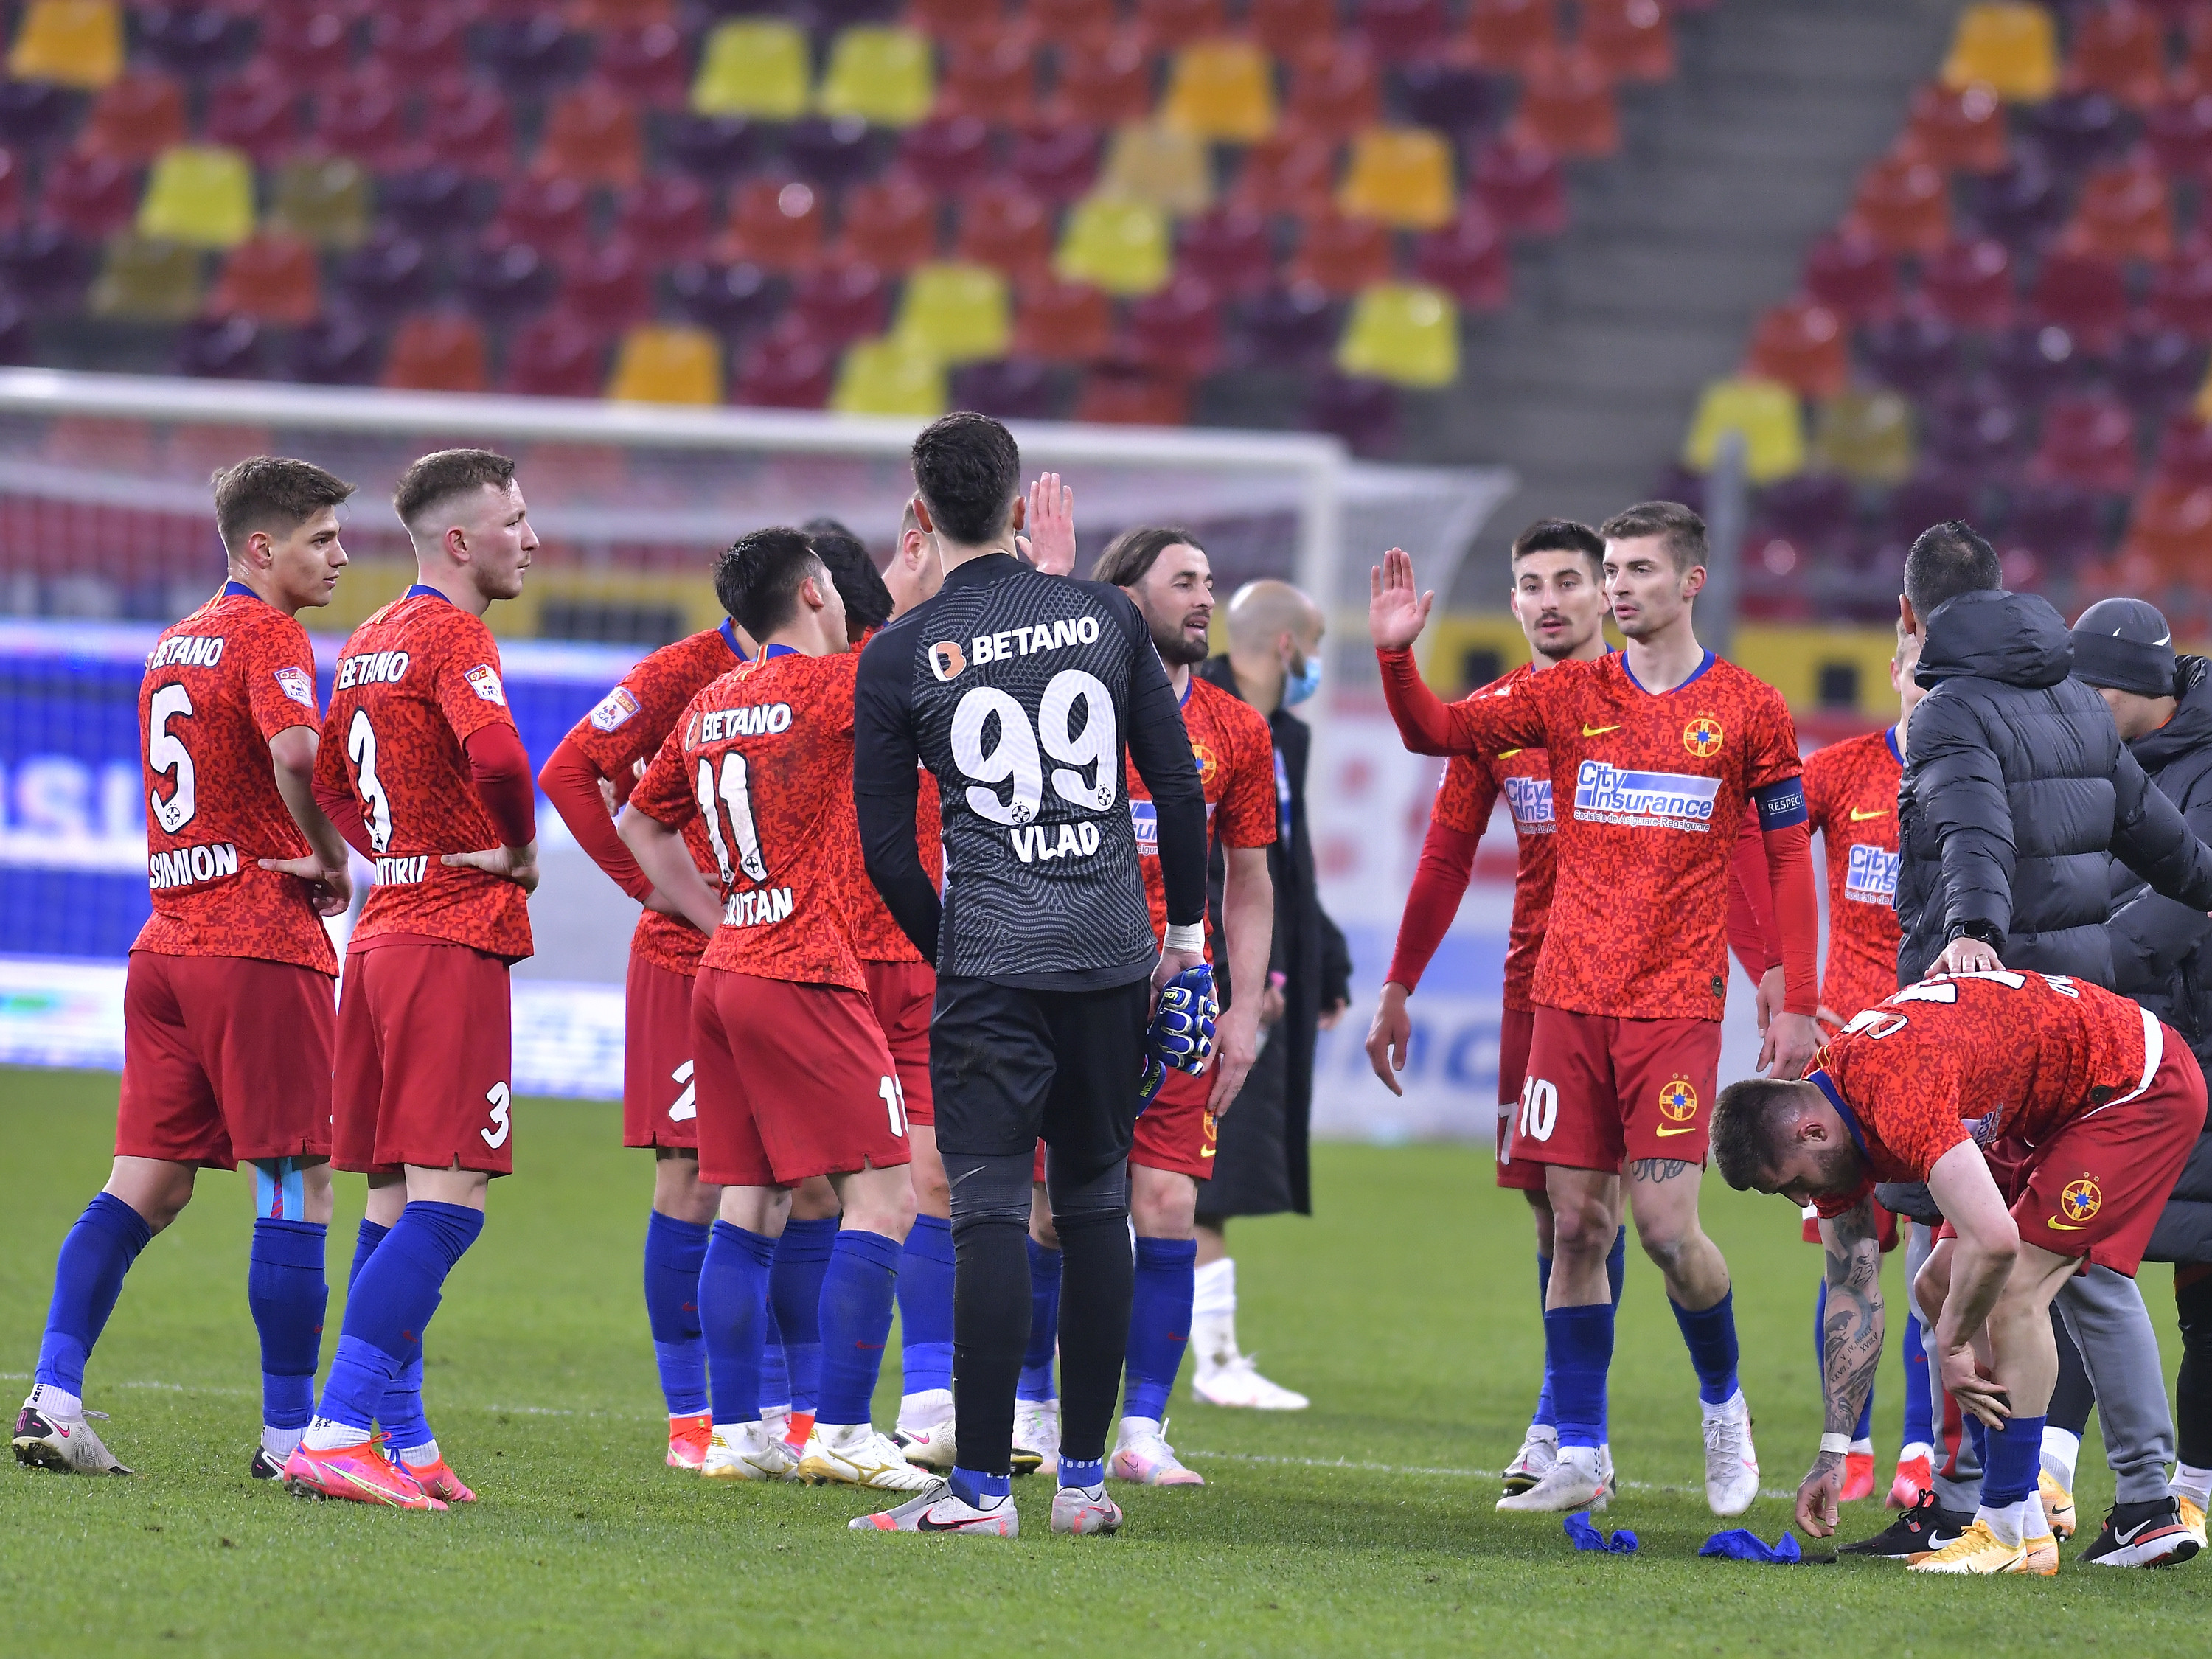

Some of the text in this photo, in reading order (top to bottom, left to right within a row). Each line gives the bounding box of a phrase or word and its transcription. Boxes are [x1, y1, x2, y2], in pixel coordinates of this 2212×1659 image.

[151, 635, 225, 670] BETANO
[972, 616, 1100, 667] BETANO
[338, 650, 411, 690] BETANO
[700, 702, 793, 744] BETANO
[149, 683, 196, 834] 5
[950, 669, 1118, 826] 99
[1505, 779, 1548, 807] City
[1579, 762, 1627, 795] City
[697, 751, 769, 885] 11
[1574, 810, 1607, 822] Societate
[1607, 813, 1618, 823] de
[1591, 790, 1712, 818] Insurance
[1010, 821, 1100, 863] VLAD
[1850, 846, 1899, 876] City
[150, 843, 239, 890] SIMION
[480, 1081, 510, 1150] 3
[1520, 1075, 1558, 1141] 10
